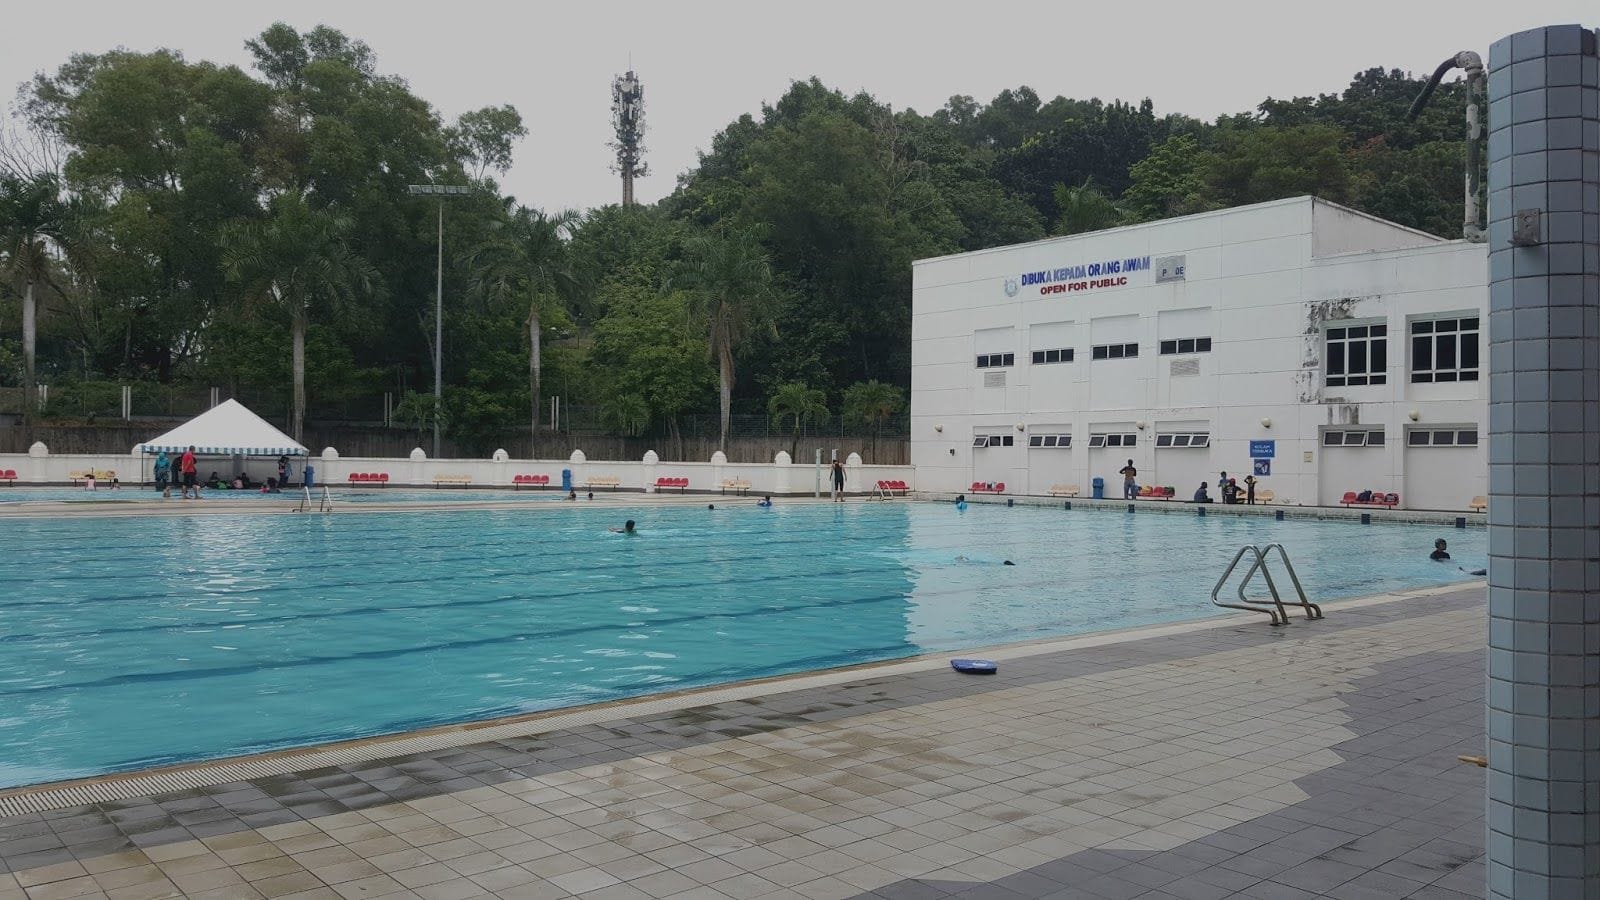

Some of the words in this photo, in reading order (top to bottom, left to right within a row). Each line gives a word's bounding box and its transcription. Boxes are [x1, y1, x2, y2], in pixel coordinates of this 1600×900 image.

[1021, 271, 1052, 286] DIBUKA
[1053, 265, 1086, 282] KEPADA
[1088, 260, 1120, 276] ORANG
[1122, 256, 1151, 272] AWAM
[1040, 284, 1066, 295] OPEN
[1068, 281, 1087, 292] FOR
[1089, 276, 1128, 289] PUBLIC
